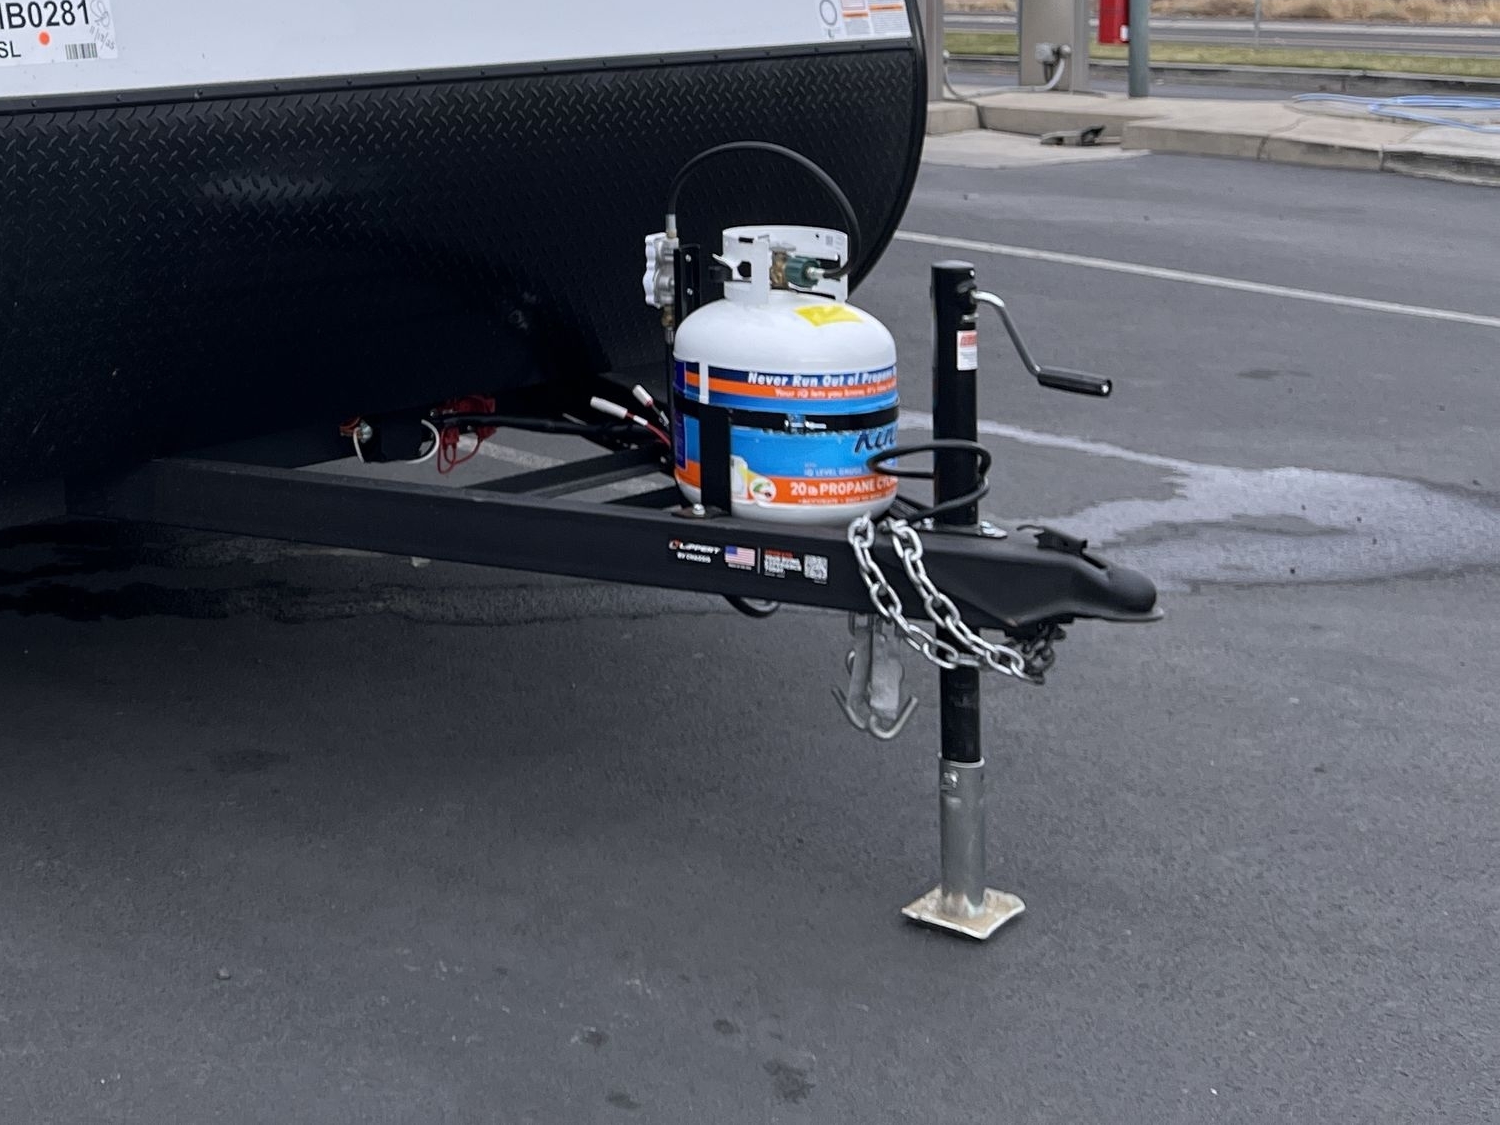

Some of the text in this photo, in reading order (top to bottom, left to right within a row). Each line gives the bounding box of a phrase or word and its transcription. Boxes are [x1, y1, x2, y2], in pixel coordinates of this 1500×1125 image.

[748, 372, 788, 387] Never
[792, 374, 818, 387] Run
[822, 374, 845, 387] Out
[847, 373, 858, 386] of
[819, 478, 875, 495] PROPANE
[679, 542, 721, 555] LIPPERT
